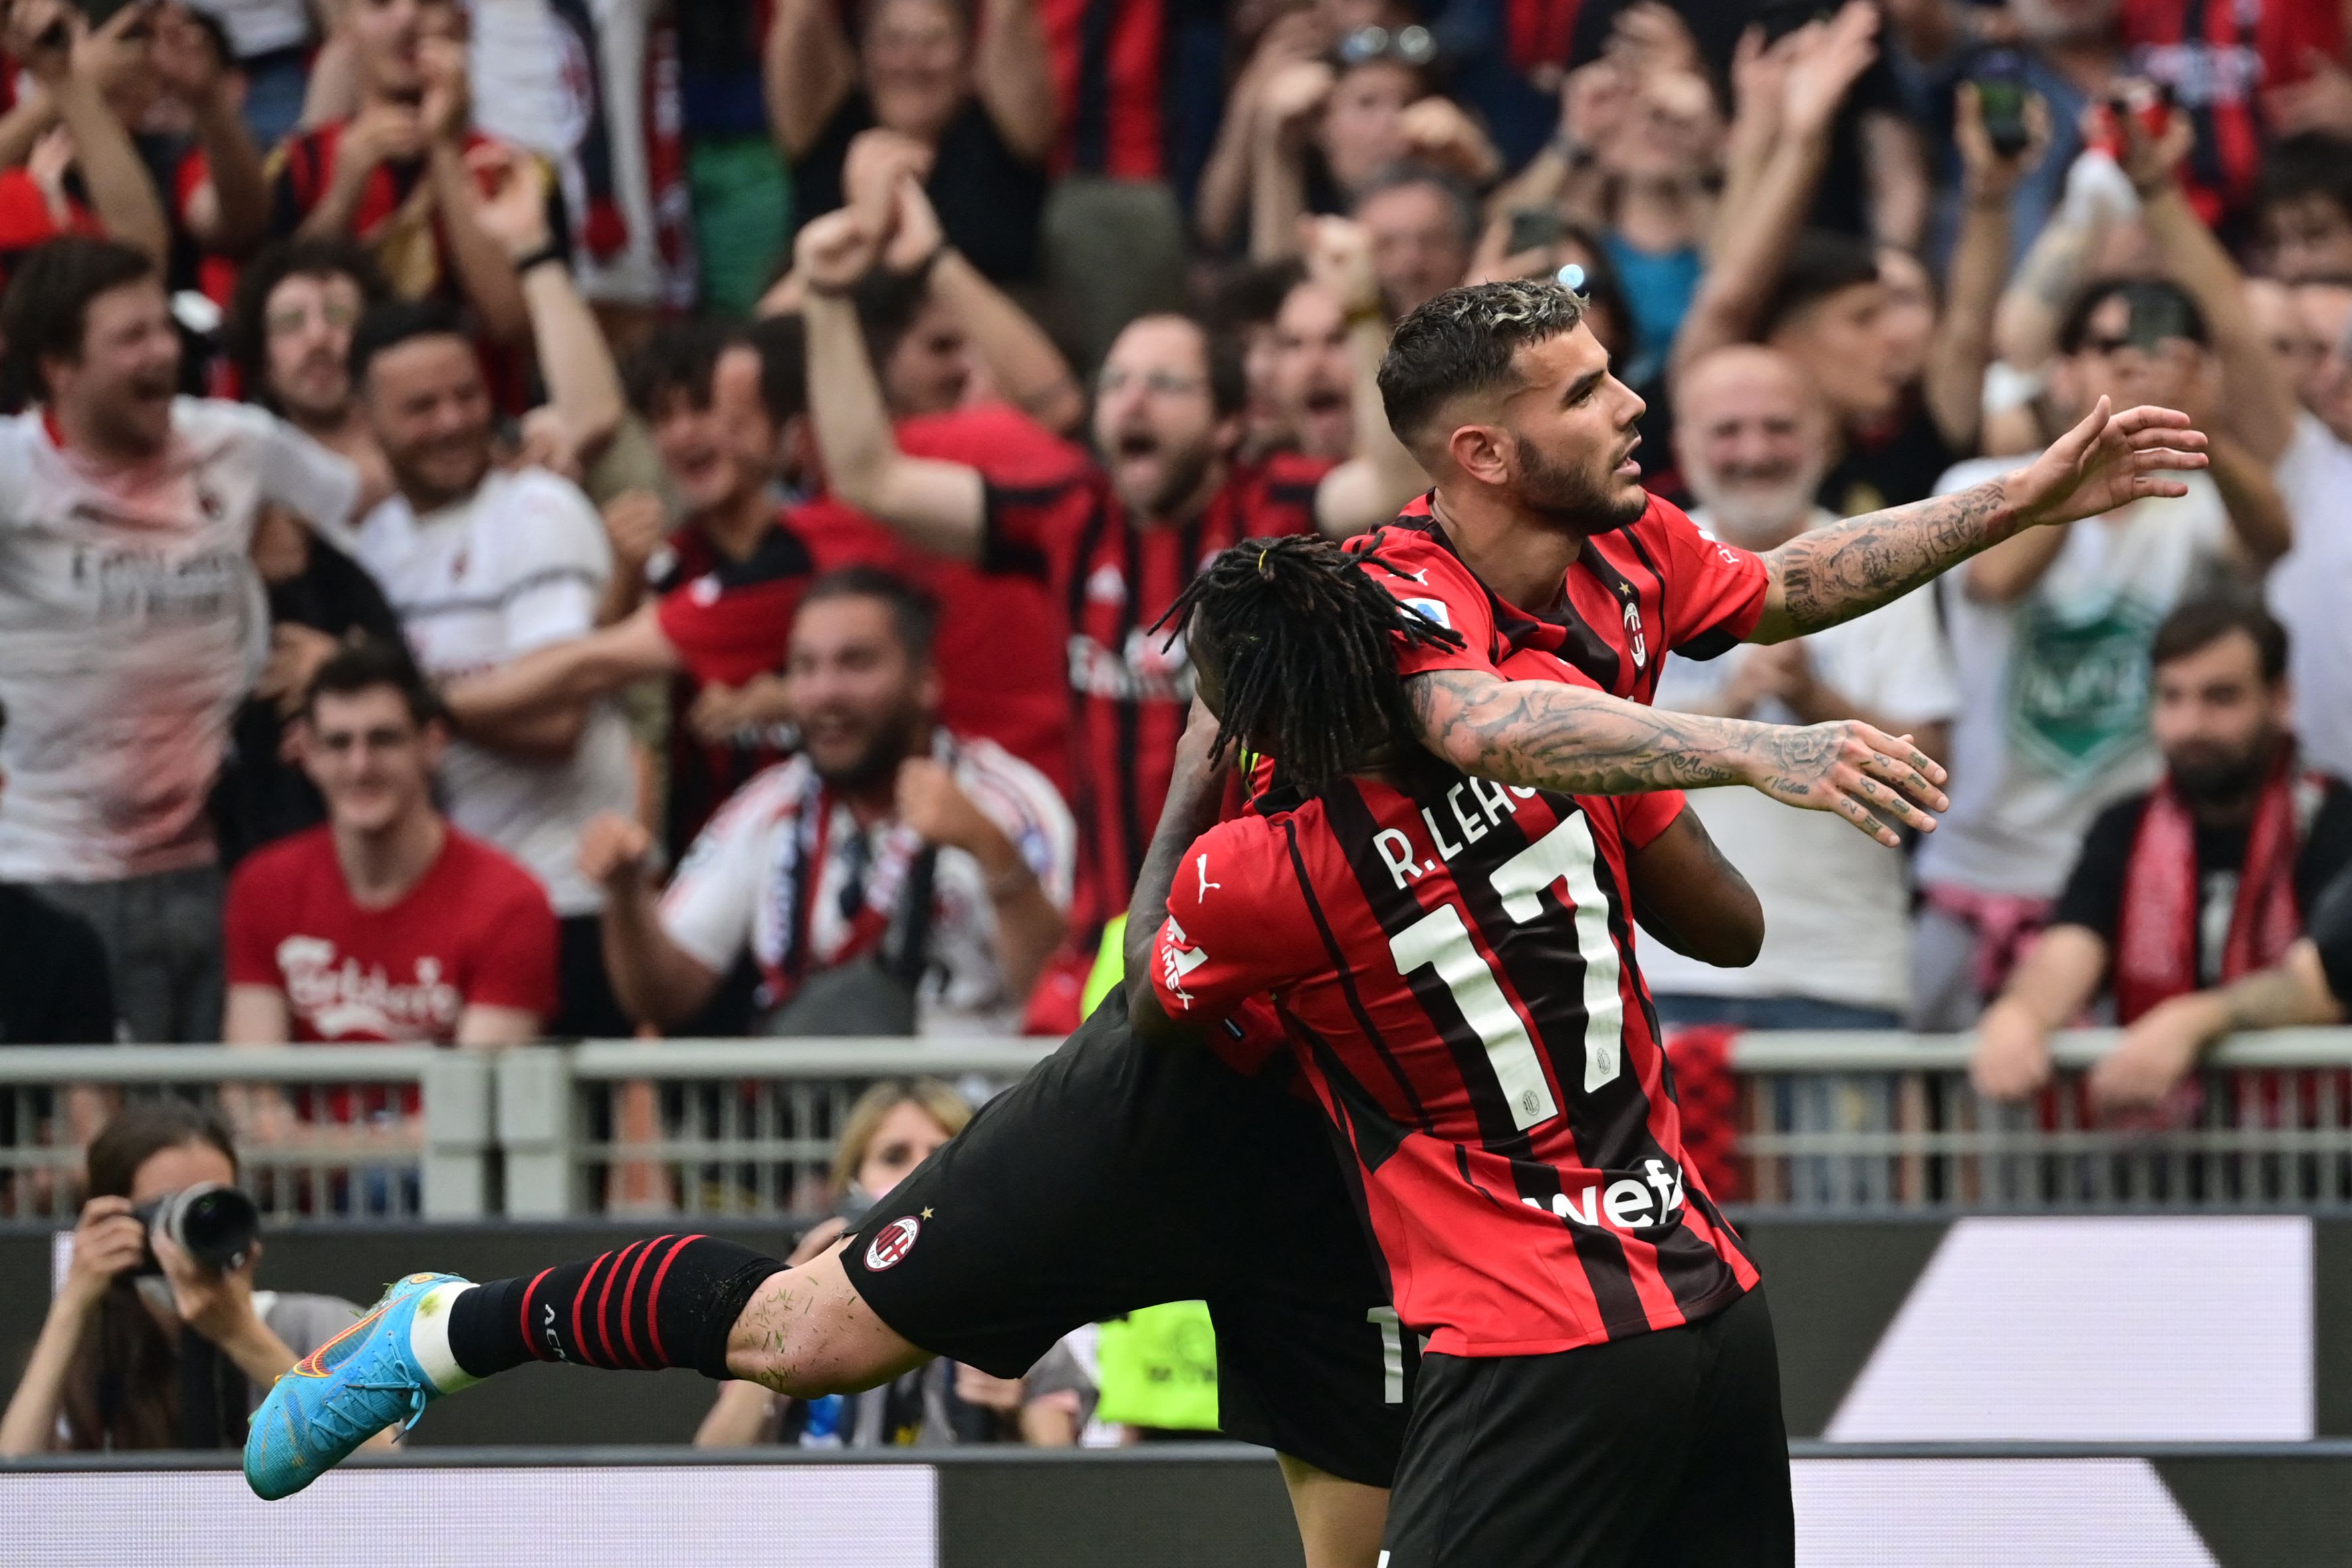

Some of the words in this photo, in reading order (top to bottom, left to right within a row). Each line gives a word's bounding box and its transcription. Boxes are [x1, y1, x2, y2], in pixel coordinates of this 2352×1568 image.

[1389, 809, 1623, 1132] 17
[901, 1220, 915, 1240] ACM
[869, 1249, 882, 1267] 1899
